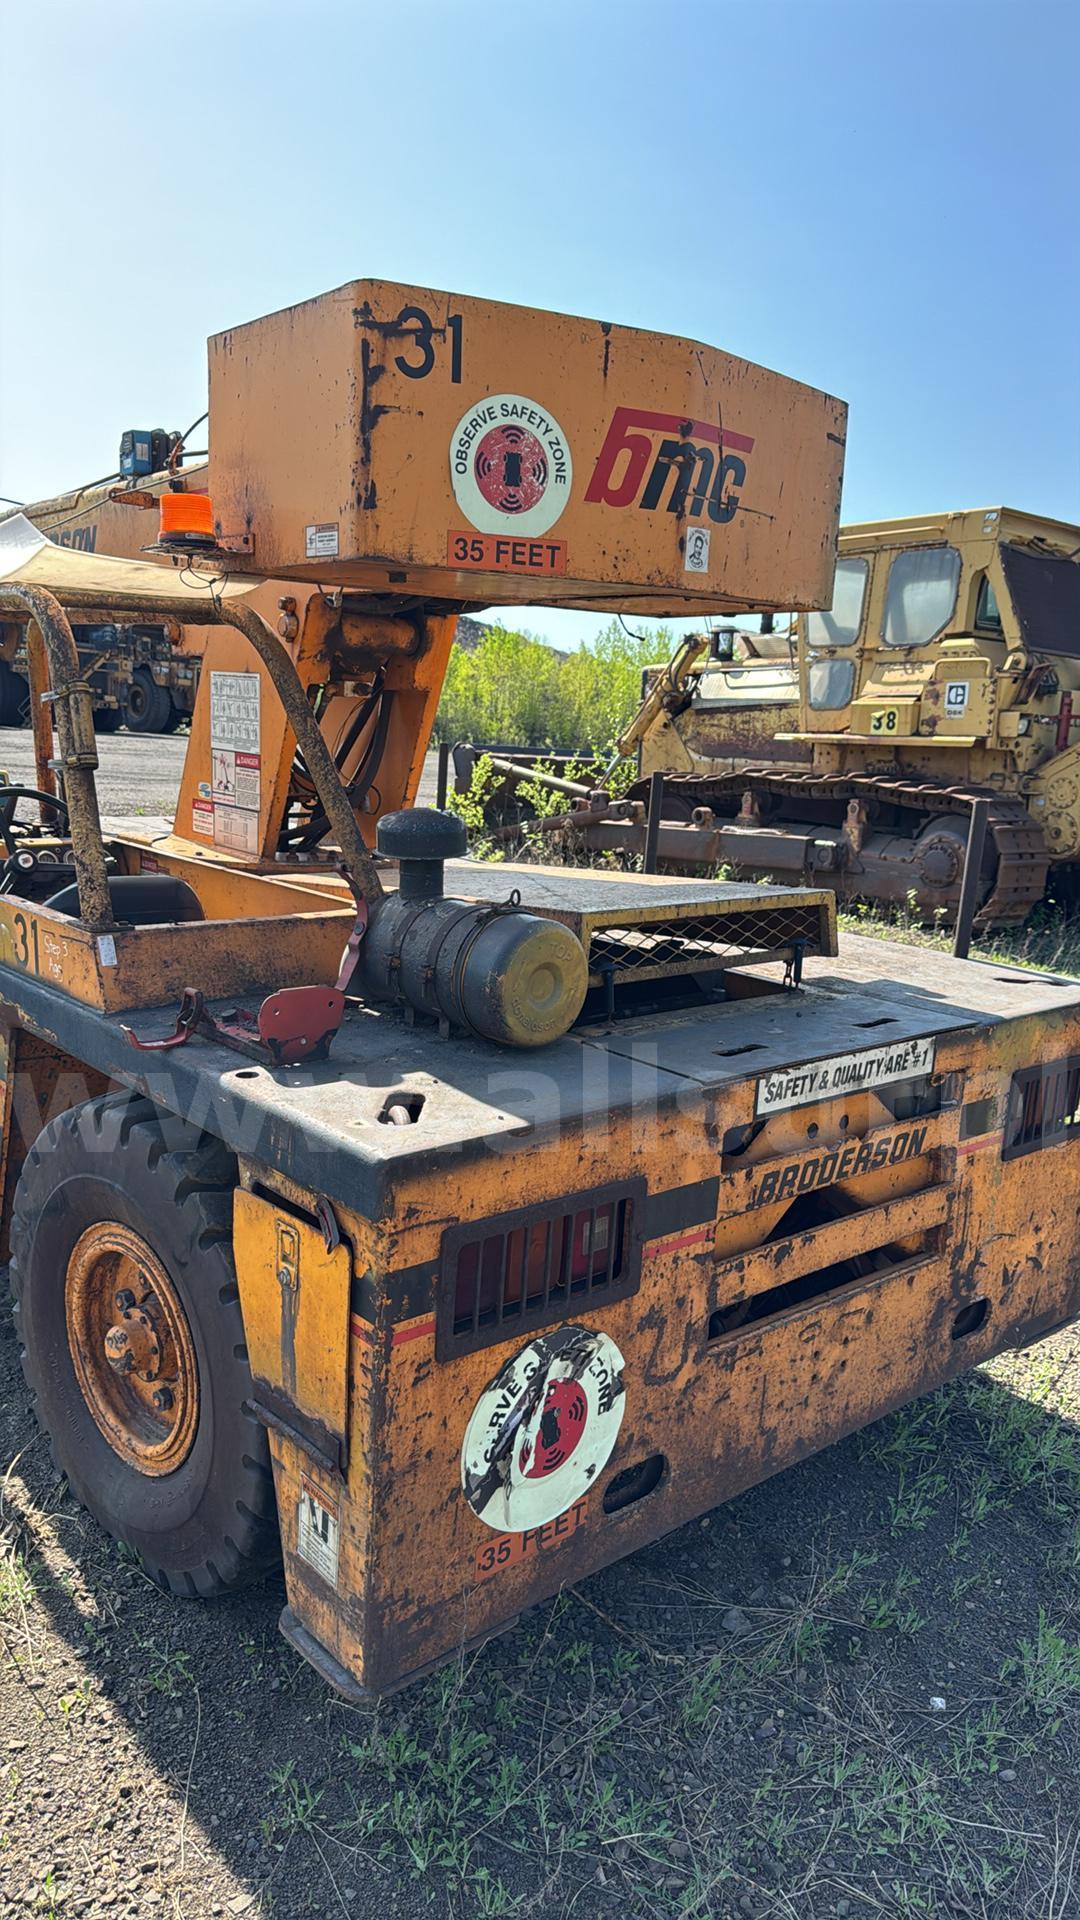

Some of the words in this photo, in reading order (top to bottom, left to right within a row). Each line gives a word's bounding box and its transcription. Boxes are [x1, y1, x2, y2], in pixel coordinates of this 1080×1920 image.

[395, 306, 462, 384] 31
[455, 406, 498, 475] OBSERVE
[500, 403, 552, 436] SAFETY
[548, 436, 566, 485] ZONE
[454, 537, 484, 562] 35
[495, 540, 561, 568] FEET
[14, 912, 40, 976] 31
[764, 1072, 818, 1104] SAFETY
[818, 1070, 829, 1090] &
[832, 1057, 885, 1088] QUALITY
[885, 1050, 910, 1076] ARE
[912, 1048, 929, 1067] #1
[757, 1126, 928, 1201] BRODERSON
[481, 1538, 512, 1571] 35
[522, 1502, 587, 1553] FEET
